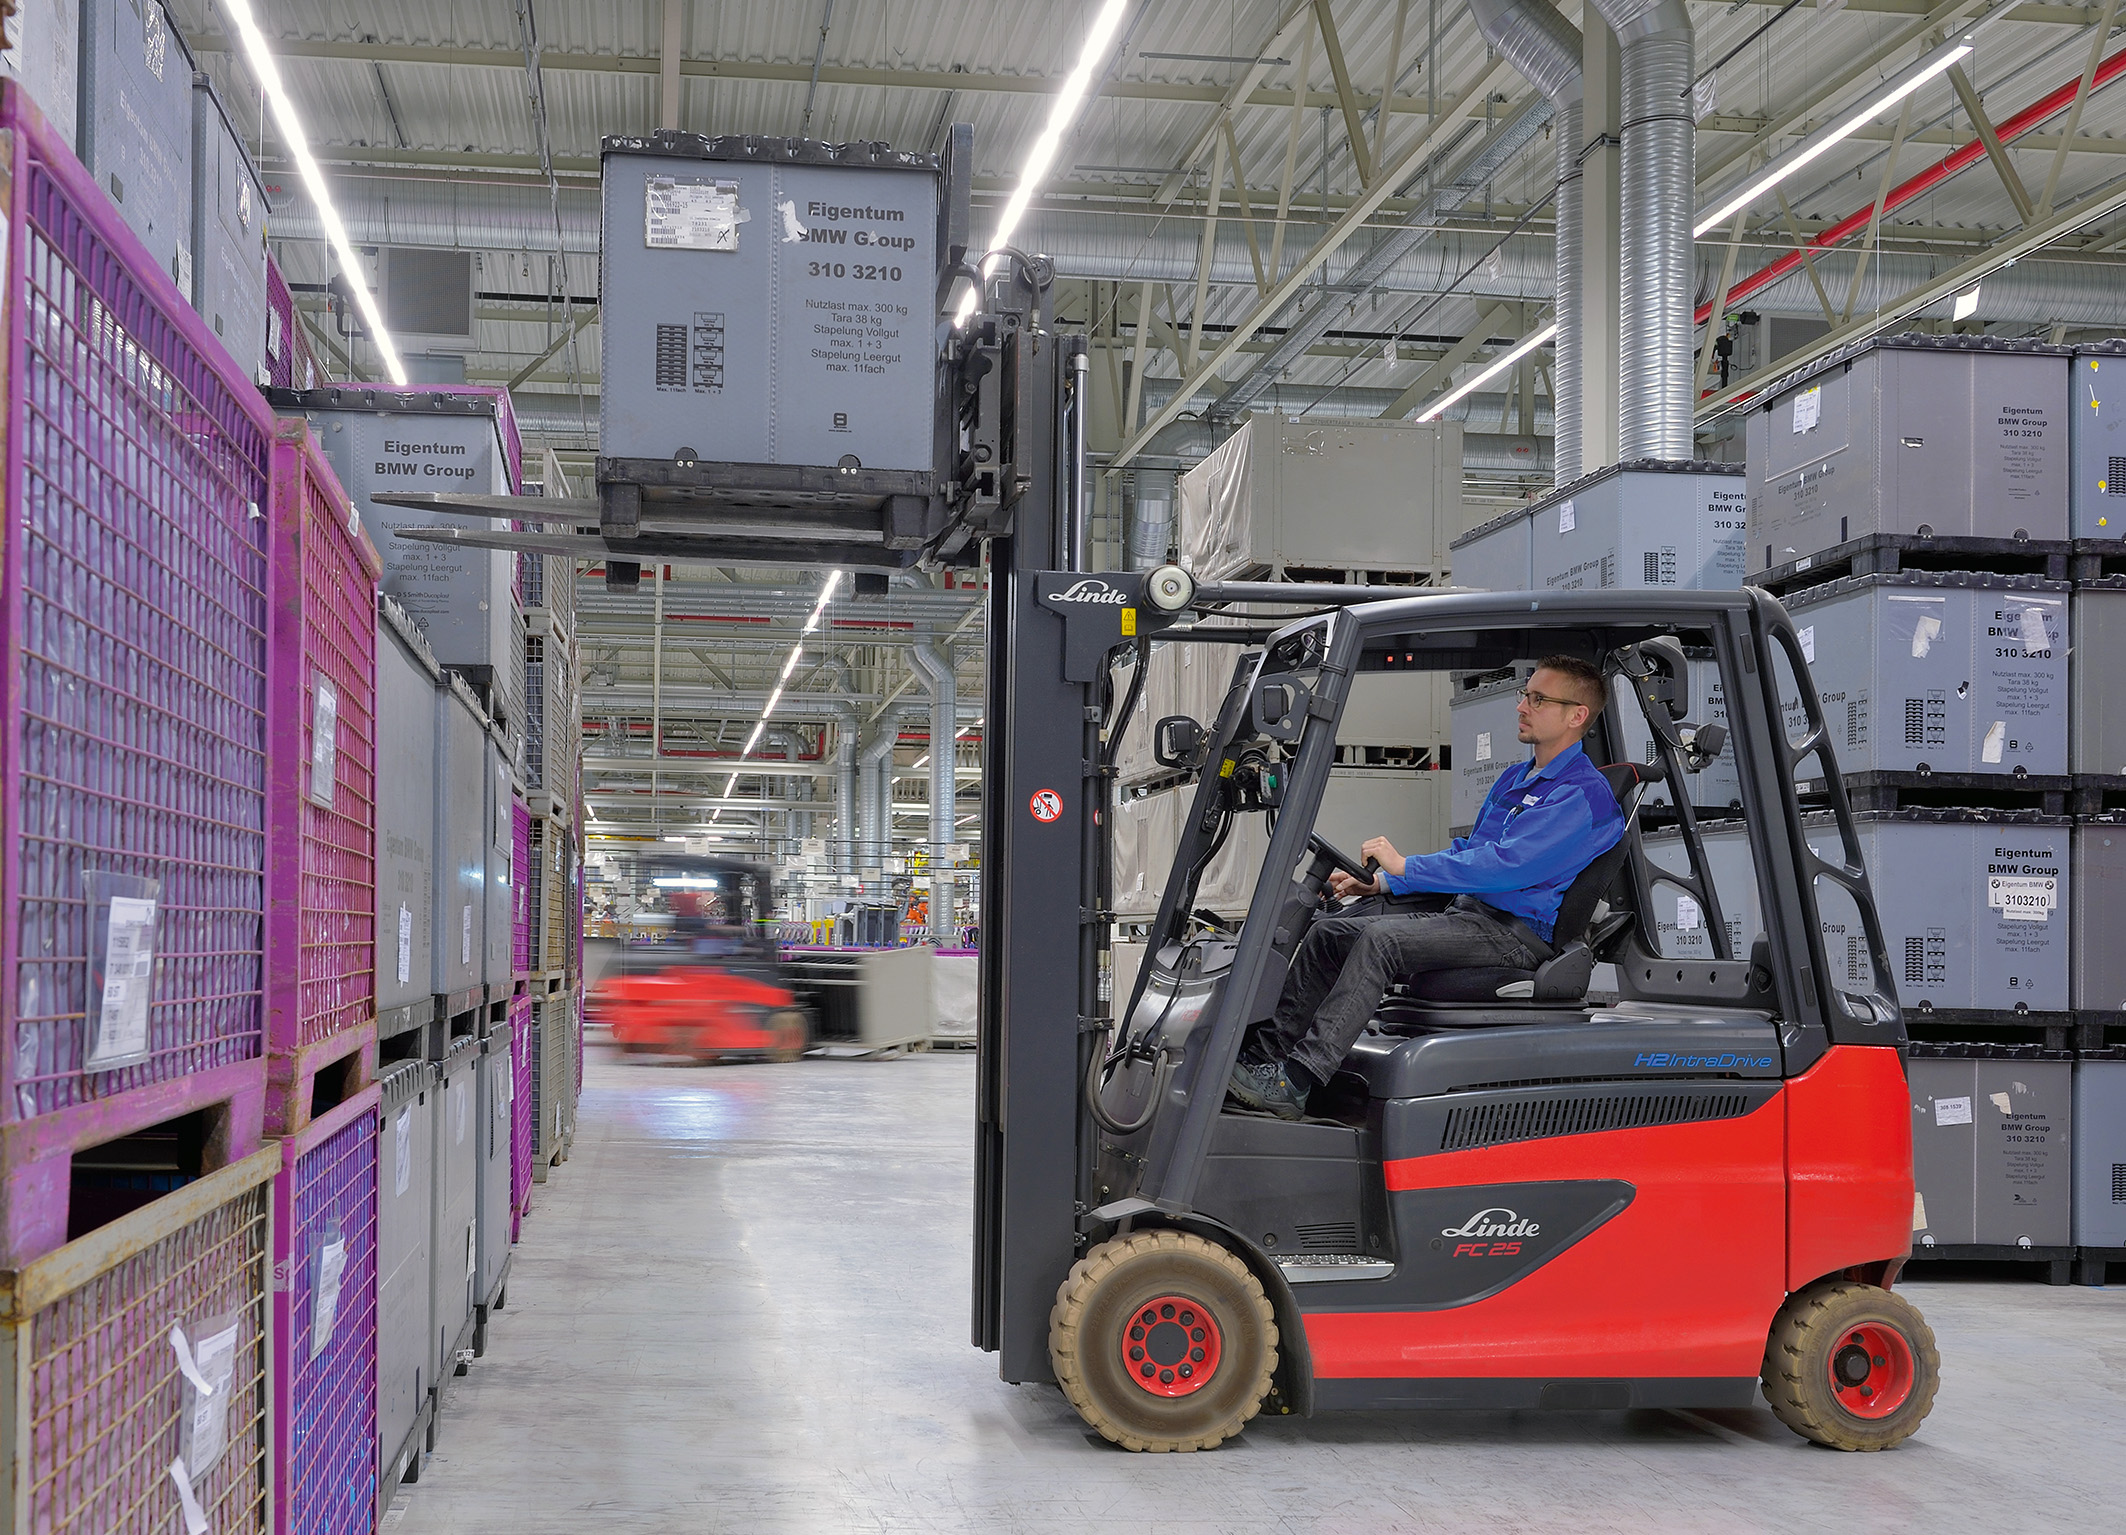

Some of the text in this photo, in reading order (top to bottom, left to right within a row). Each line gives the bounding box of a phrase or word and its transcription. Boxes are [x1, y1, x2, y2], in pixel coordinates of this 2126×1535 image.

[808, 201, 904, 221] Eigentum
[808, 262, 902, 281] 310 3210
[805, 299, 908, 316] Nutzlast max. 300 kg
[831, 313, 882, 327] Tara 38 kg
[813, 324, 899, 339] Stapelung Vollgut
[830, 339, 854, 348] max.
[858, 340, 862, 348] 1
[876, 340, 882, 349] 3
[811, 349, 901, 364] Stapelung Leergut
[826, 363, 885, 374] max. 11fach
[2003, 406, 2043, 415] Eigentum
[2022, 418, 2047, 427] Group
[384, 441, 465, 456] Eigentum
[375, 462, 475, 480] BMW Group
[1714, 491, 1746, 501] Eigent
[1793, 484, 1819, 501] 310 3210
[1708, 504, 1732, 512] BMW
[1714, 520, 1746, 529] 310 32
[388, 541, 460, 553] Stapelung Vollgut
[386, 563, 462, 573] Stapelung Leergut
[1048, 579, 1127, 605] Linde
[1988, 627, 2018, 637] BMW
[1995, 647, 2017, 658] 310
[1997, 686, 2026, 694] Stapelung
[1822, 691, 1846, 703] Group
[1996, 701, 2025, 709] Stapelung
[1788, 715, 1801, 728] 310
[1995, 847, 2053, 859] Eigentum
[1988, 864, 2059, 877] BMW Group
[2005, 894, 2046, 907] 3103210
[1822, 922, 1846, 935] Group
[1997, 923, 2026, 931] Stapelung
[1676, 935, 1702, 945] 310 3210
[1996, 938, 2025, 946] Stapelung
[1634, 1053, 1772, 1067] H2IntraDrive
[2006, 1112, 2046, 1121] Eigentum
[2025, 1124, 2050, 1133] Group
[1441, 1207, 1540, 1237] Linde
[1453, 1242, 1522, 1257] FC 25
